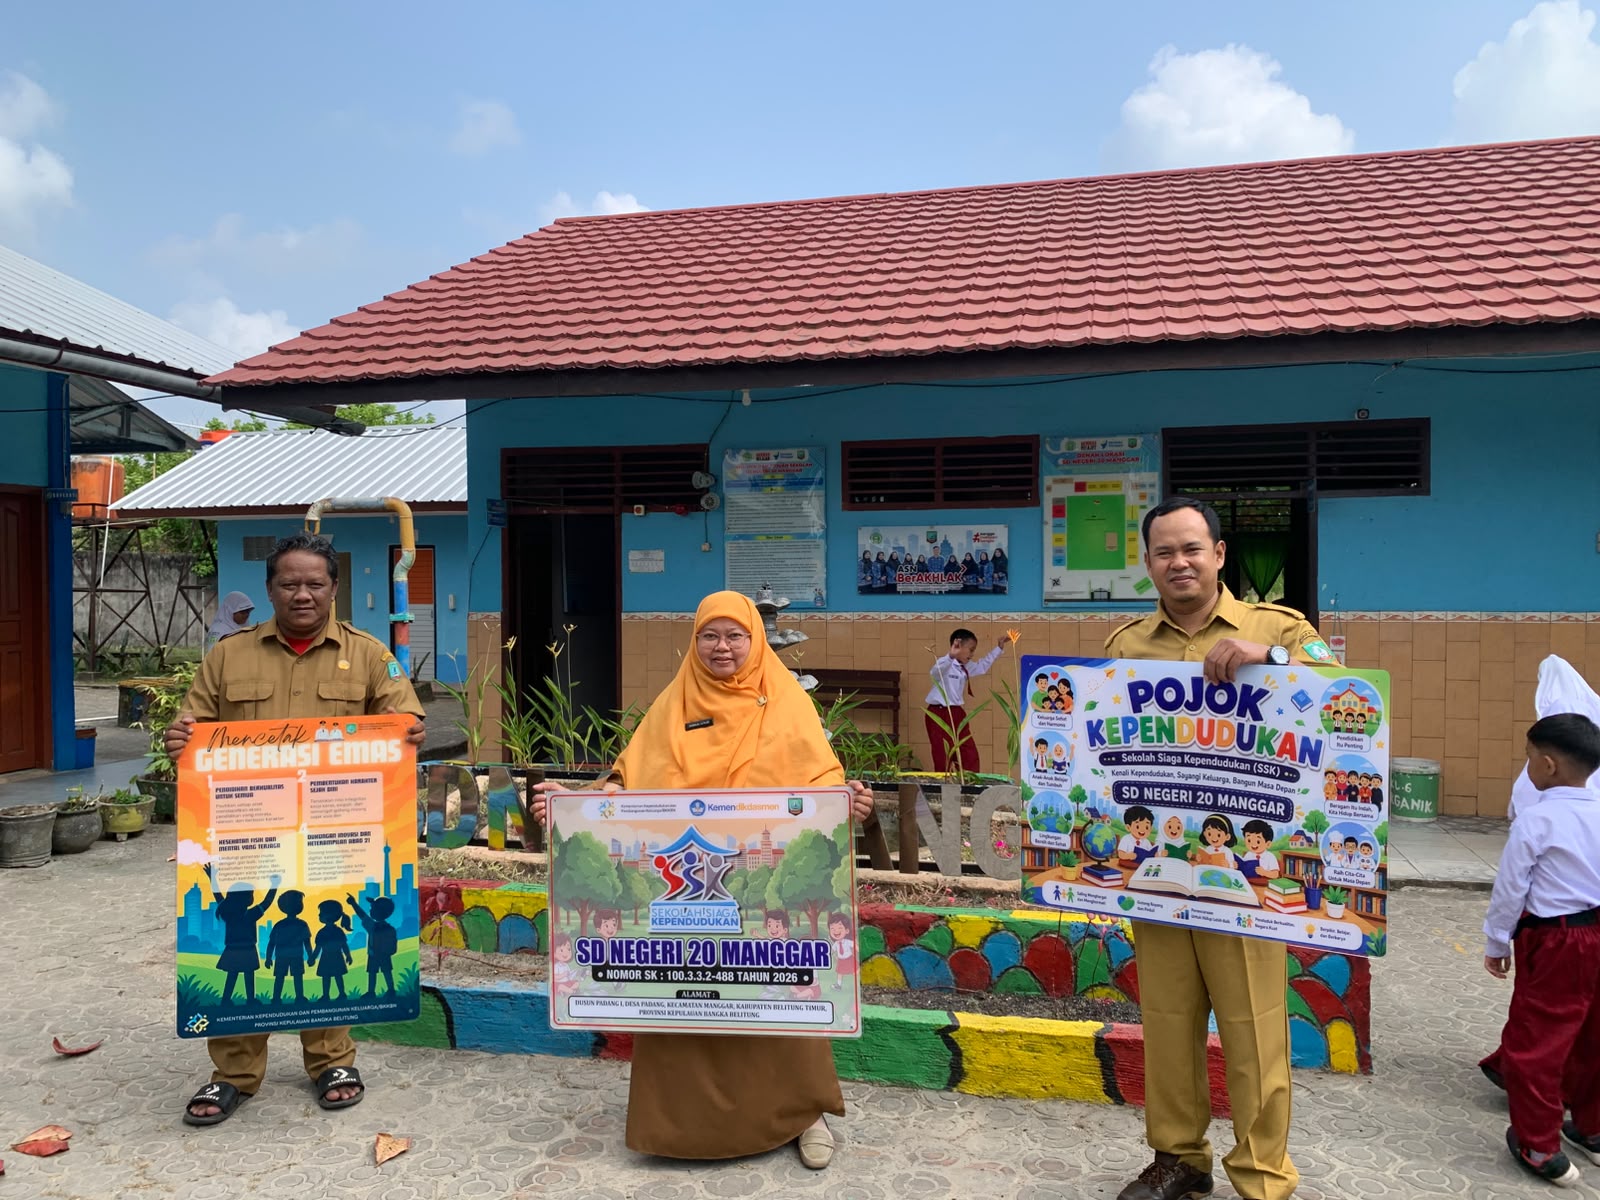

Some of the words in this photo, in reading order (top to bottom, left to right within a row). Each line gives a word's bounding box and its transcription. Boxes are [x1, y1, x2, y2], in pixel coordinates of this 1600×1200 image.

[897, 573, 962, 582] BerAKHLAK
[1127, 676, 1271, 721] POJOK
[207, 723, 311, 752] Mencetak
[1086, 716, 1324, 769] KEPENDUDUKAN
[195, 743, 320, 772] GENERASI
[330, 739, 402, 764] EMAS
[1122, 752, 1155, 763] Sekolah
[1157, 754, 1182, 767] Siaga
[1184, 756, 1251, 772] Kependudukan
[1253, 762, 1281, 777] (SSK)
[297, 769, 307, 783] 2
[1112, 768, 1129, 777] Kenali
[1131, 769, 1175, 782] Kependudukan,
[1177, 772, 1201, 784] Sayangi
[1202, 774, 1230, 786] Keluarga,
[1232, 777, 1256, 788] Bangun
[1258, 780, 1274, 789] Masa
[1276, 783, 1296, 795] Depan
[708, 803, 779, 812] Kemendikdasmen
[1122, 786, 1140, 799] SD
[1144, 787, 1192, 803] NEGERI
[1196, 792, 1213, 804] 20
[1218, 794, 1285, 816] MANGGAR
[206, 828, 216, 841] 3
[651, 918, 738, 926] KEPENDUDUKAN
[652, 908, 702, 917] SEKOLAH
[706, 908, 737, 917] SIAGA
[576, 939, 606, 966] SD
[610, 939, 683, 966] NEGERI
[688, 940, 717, 967] 20
[722, 940, 830, 969] MANGGAR
[606, 970, 642, 980] NOMOR
[644, 970, 658, 980] SK
[666, 970, 734, 981] 100.3.3.2-488
[737, 972, 770, 982] TAHUN
[773, 972, 798, 983] 2026
[255, 1011, 298, 1020] KEPENDUDUKAN
